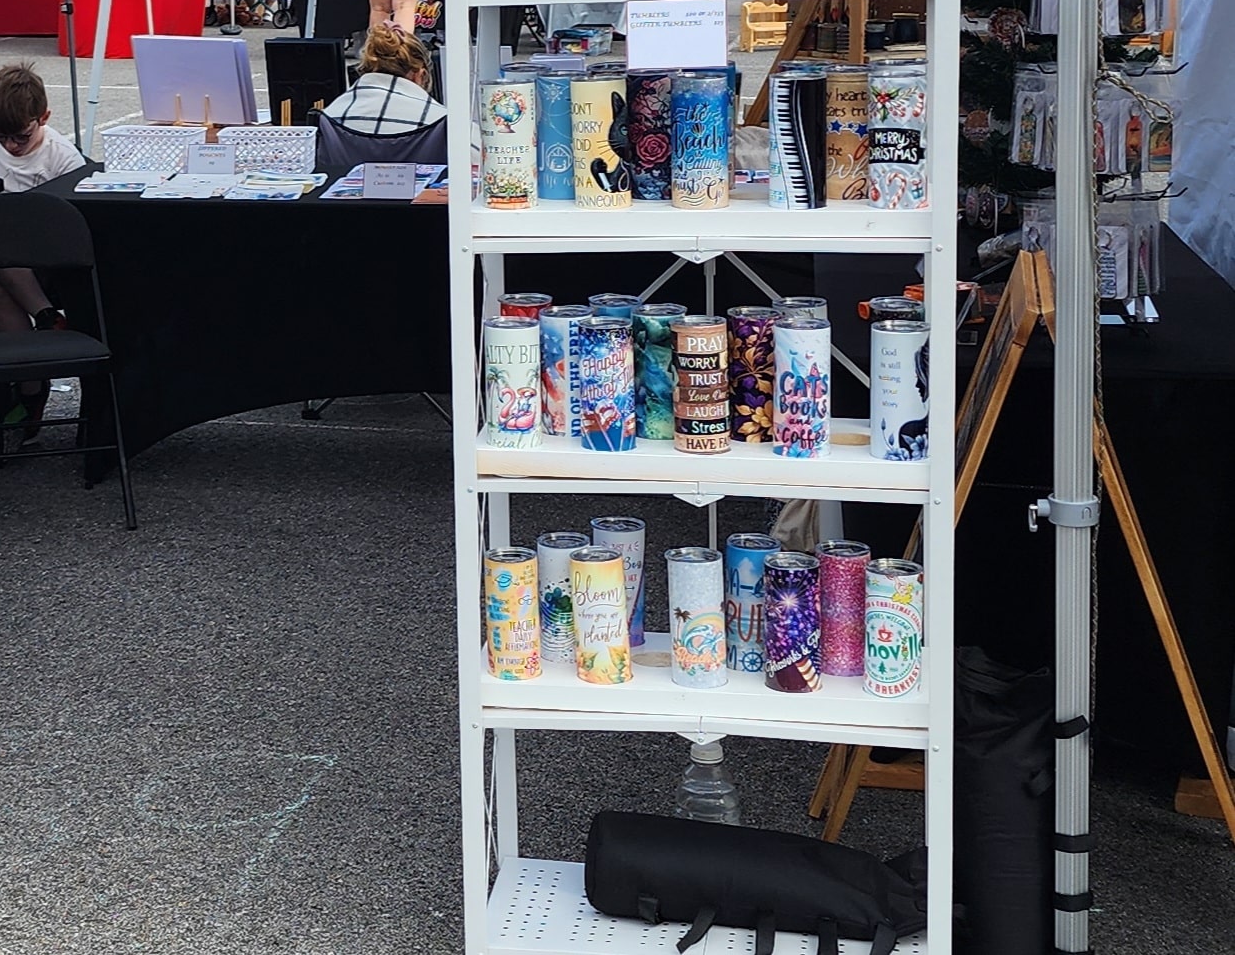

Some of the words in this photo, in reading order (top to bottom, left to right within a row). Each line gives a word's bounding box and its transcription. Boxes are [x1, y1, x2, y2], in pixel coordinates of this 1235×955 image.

[674, 122, 727, 159] Beach
[875, 132, 909, 148] MERRY
[497, 156, 522, 165] LIFE
[687, 336, 726, 352] PRAY
[881, 347, 897, 357] God
[582, 348, 628, 377] Happy
[678, 356, 718, 370] WORRY
[689, 373, 723, 386] TRUST
[779, 366, 829, 400] CATS
[688, 389, 711, 402] Love
[686, 404, 725, 418] LAUGH
[779, 399, 828, 420] BOOKS
[691, 421, 725, 435] Stress
[789, 416, 812, 427] and
[686, 437, 716, 450] HAVE
[781, 429, 828, 451] Coffee
[572, 571, 621, 607] bloom
[583, 618, 623, 646] planted
